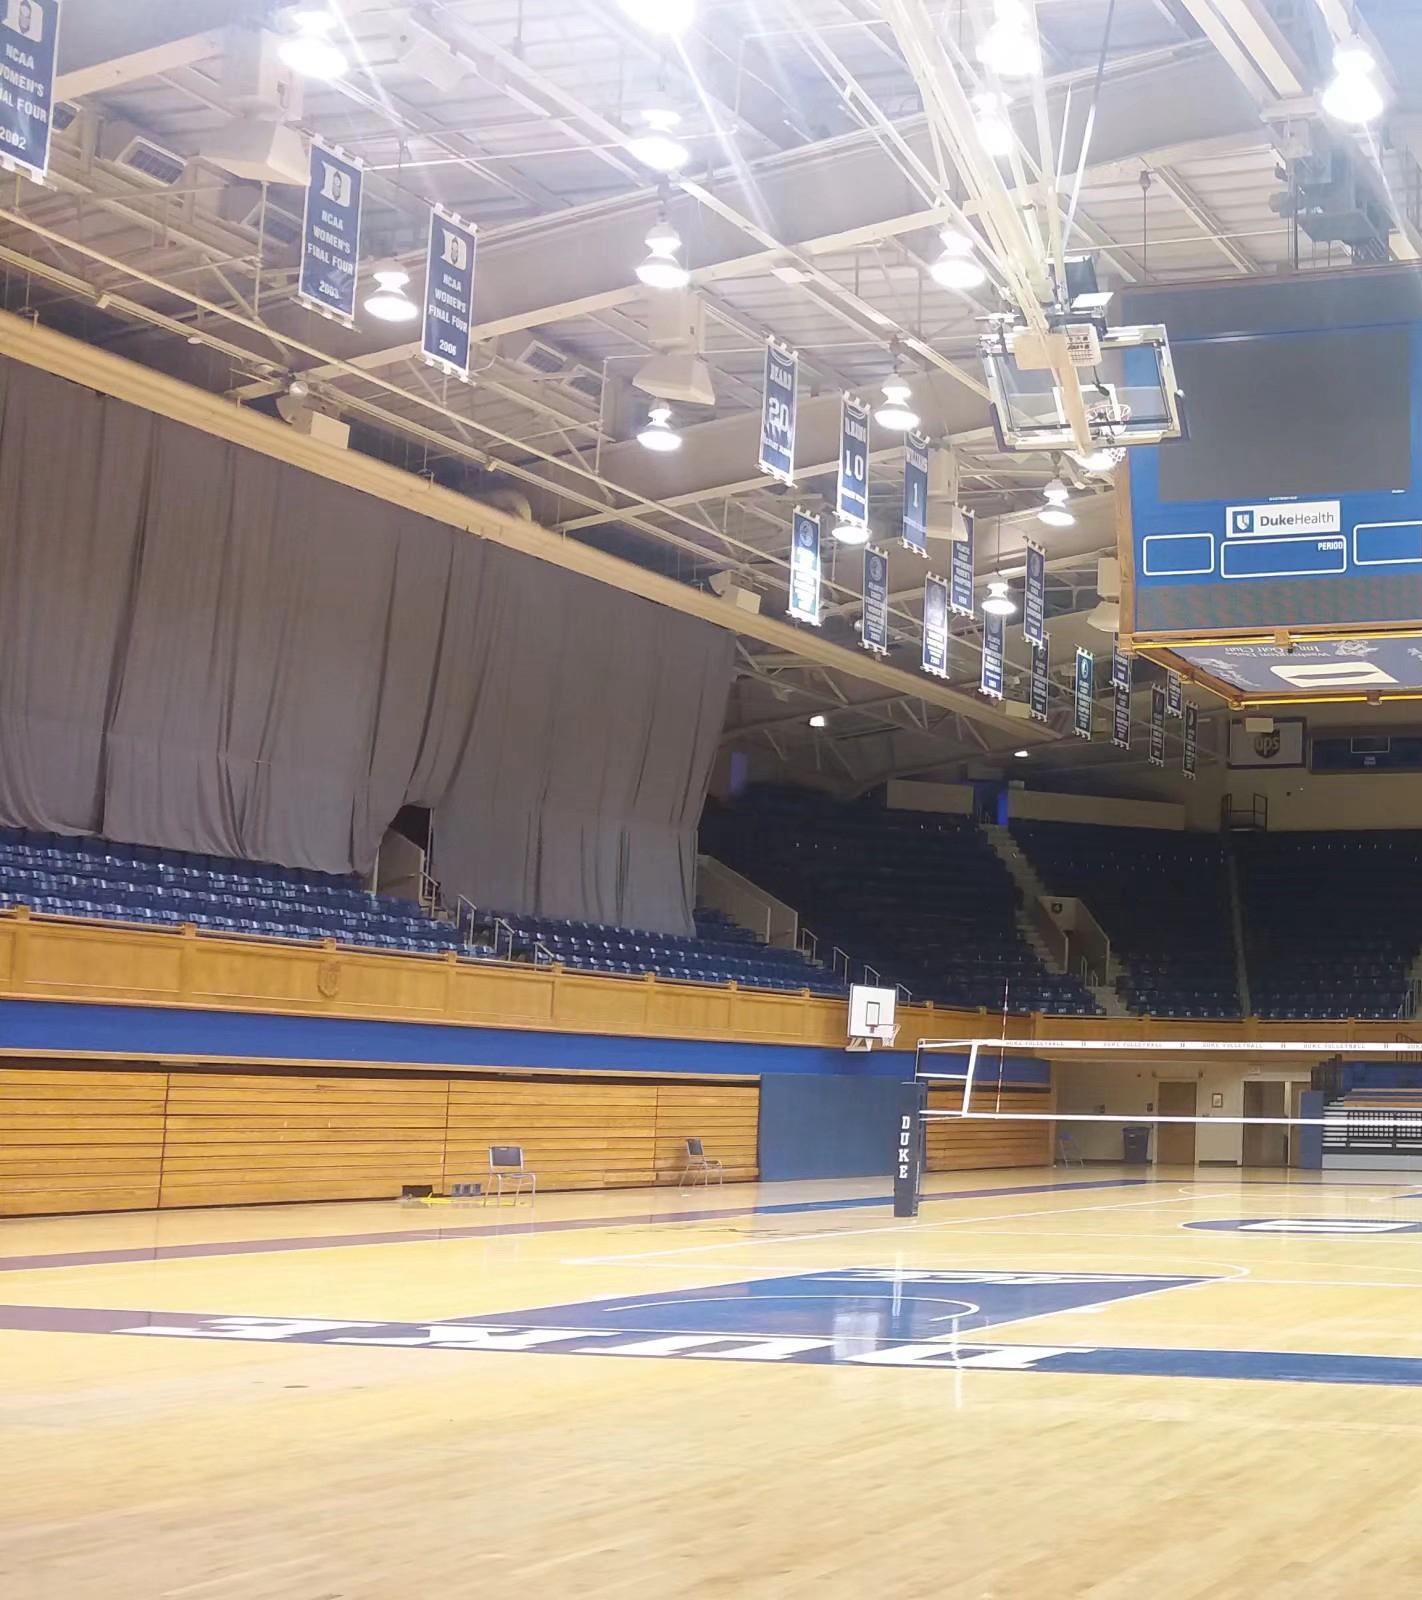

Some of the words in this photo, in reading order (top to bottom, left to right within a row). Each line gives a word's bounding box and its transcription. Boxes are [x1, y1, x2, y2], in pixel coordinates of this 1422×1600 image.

[6, 43, 34, 70] NCAA
[17, 98, 47, 123] FOUR
[0, 128, 26, 150] 2002
[321, 210, 344, 231] NCAA
[313, 225, 350, 254] WOMEN'S
[307, 243, 330, 265] FINAL
[332, 255, 353, 276] FOUR
[443, 273, 462, 292] NCAA
[428, 304, 451, 324] FINAL
[451, 315, 468, 334] FOUR
[768, 397, 789, 433] 20
[845, 449, 864, 482] 10
[912, 482, 918, 508] 1
[1260, 511, 1334, 527] DukeHealth
[1318, 541, 1343, 551] PERIOD
[1255, 736, 1280, 756] ups
[898, 1115, 911, 1179] DUKE
